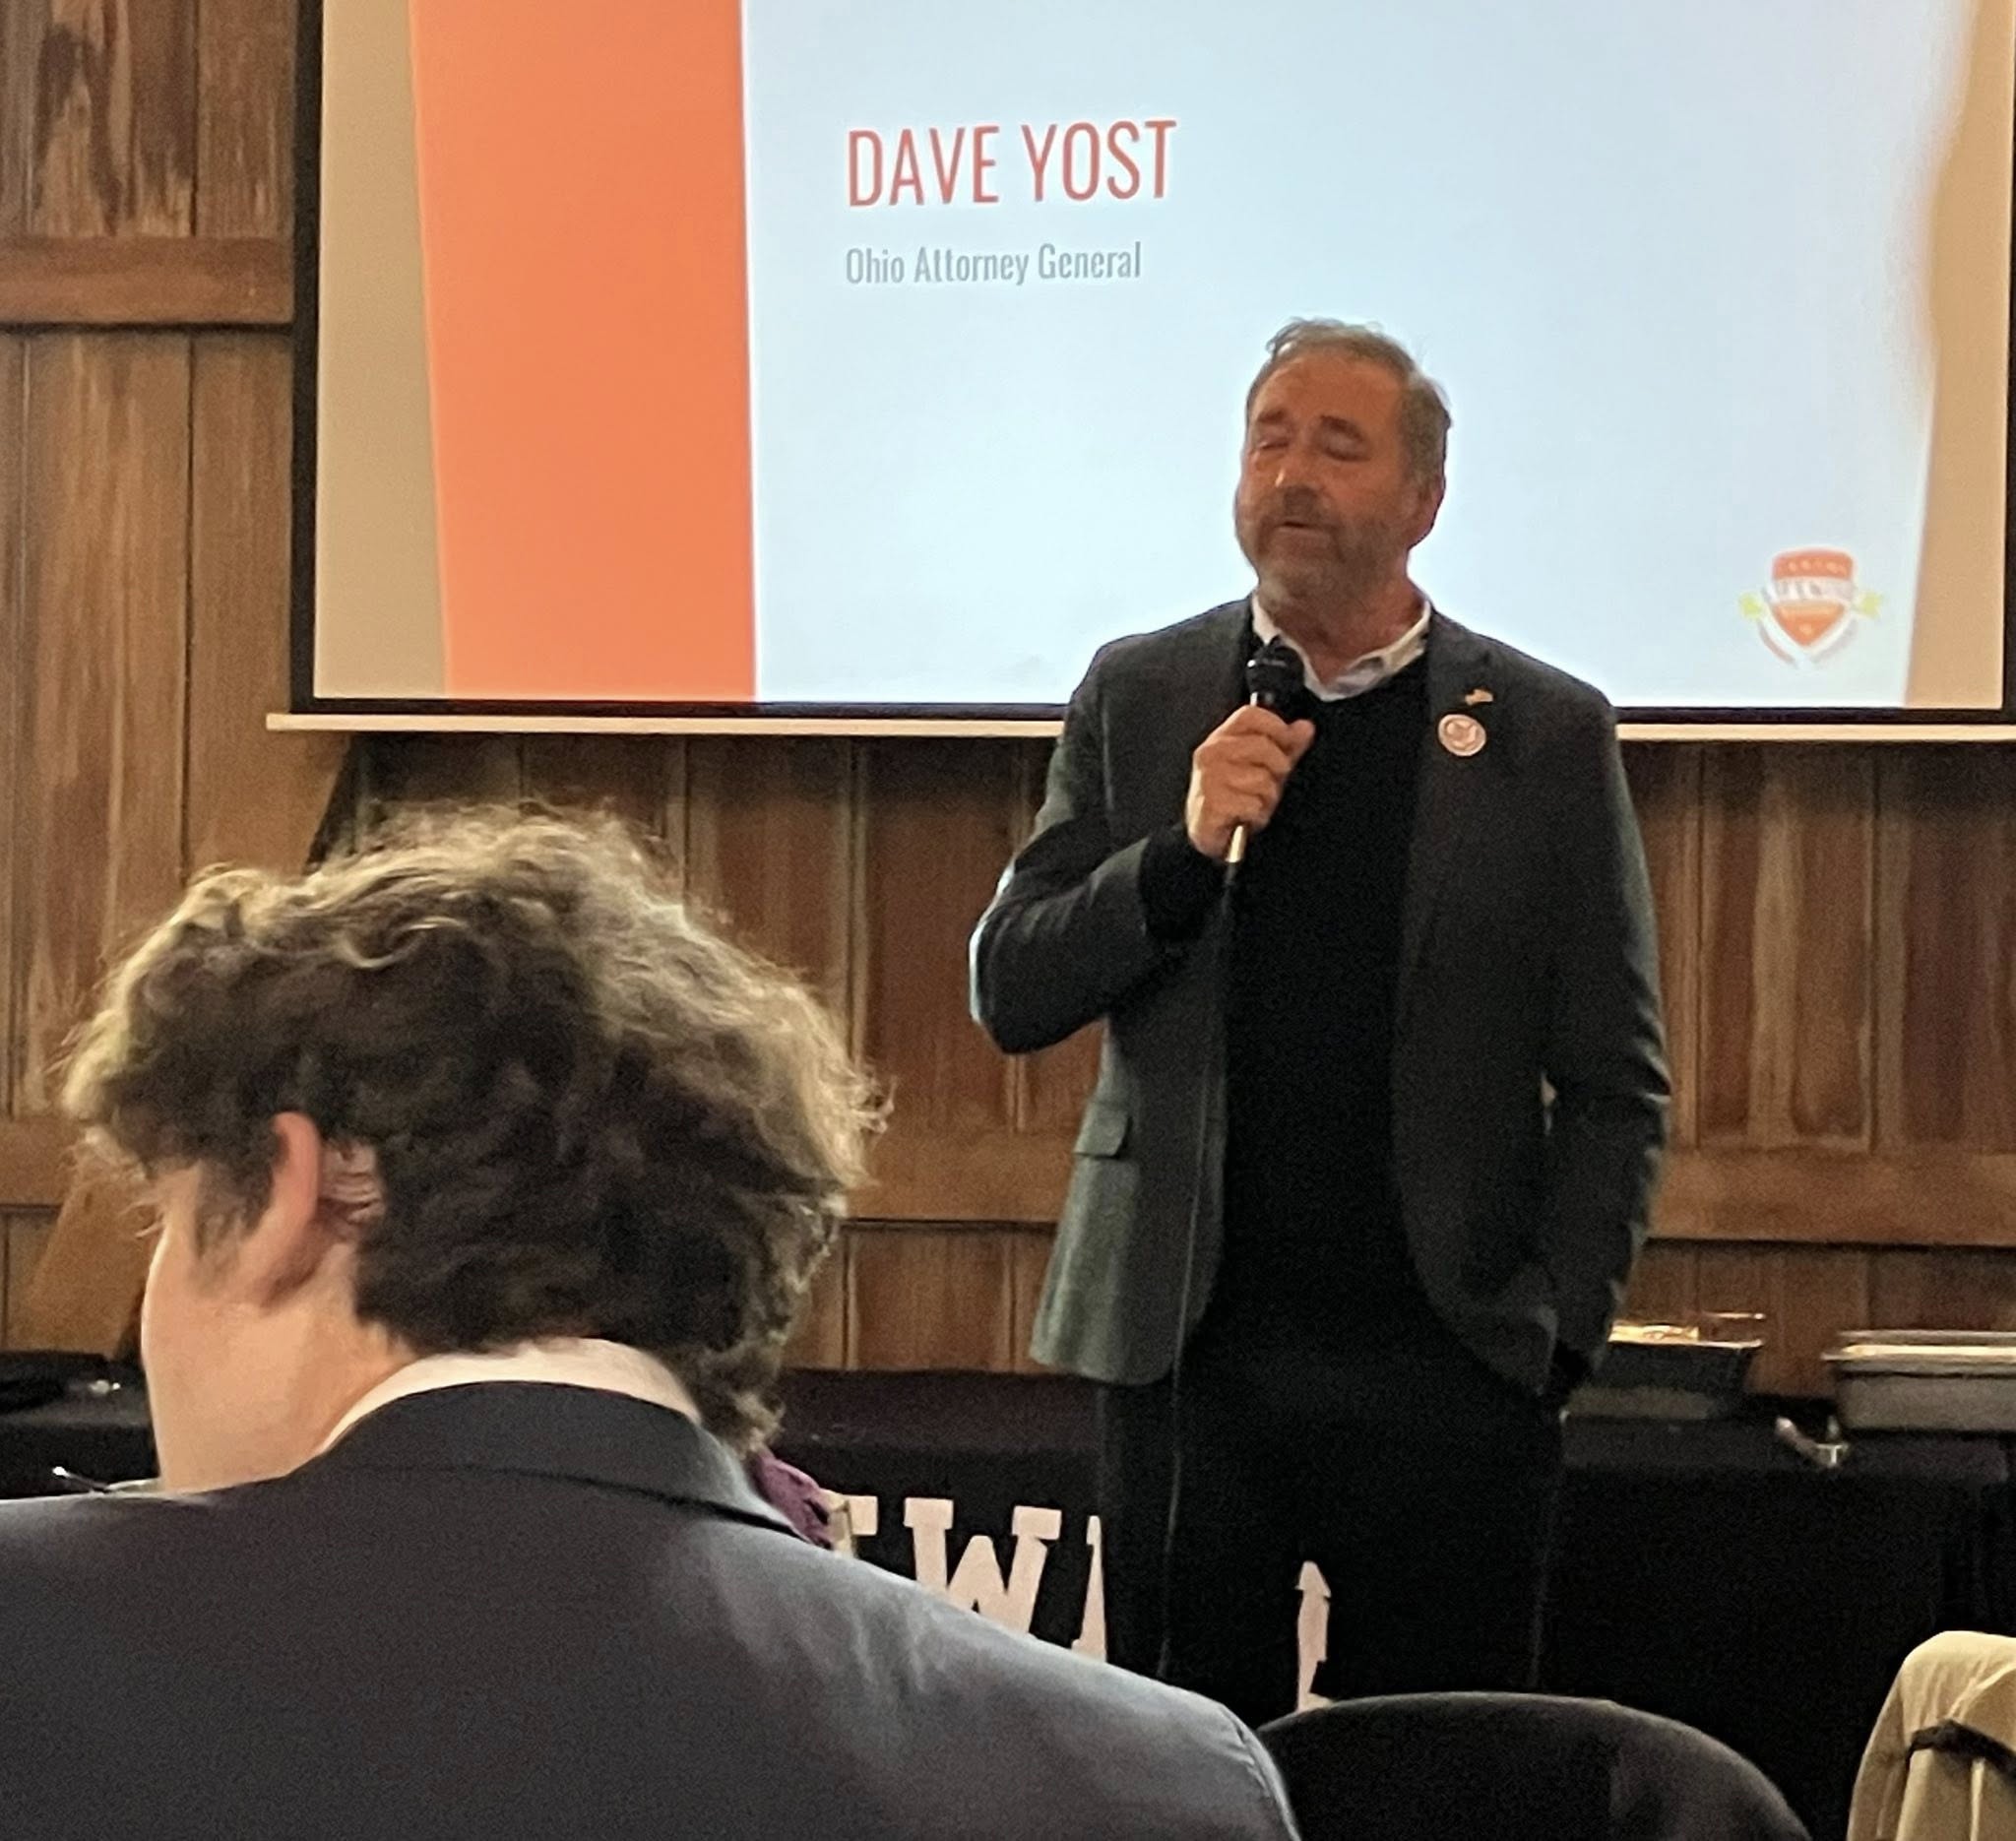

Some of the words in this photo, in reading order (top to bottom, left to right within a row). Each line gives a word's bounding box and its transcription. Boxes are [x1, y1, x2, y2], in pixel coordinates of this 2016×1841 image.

[849, 126, 999, 206] DAVE
[1022, 119, 1177, 202] YOST
[846, 247, 905, 284] Ohio
[914, 246, 1030, 286] Attorney
[1039, 241, 1142, 280] General
